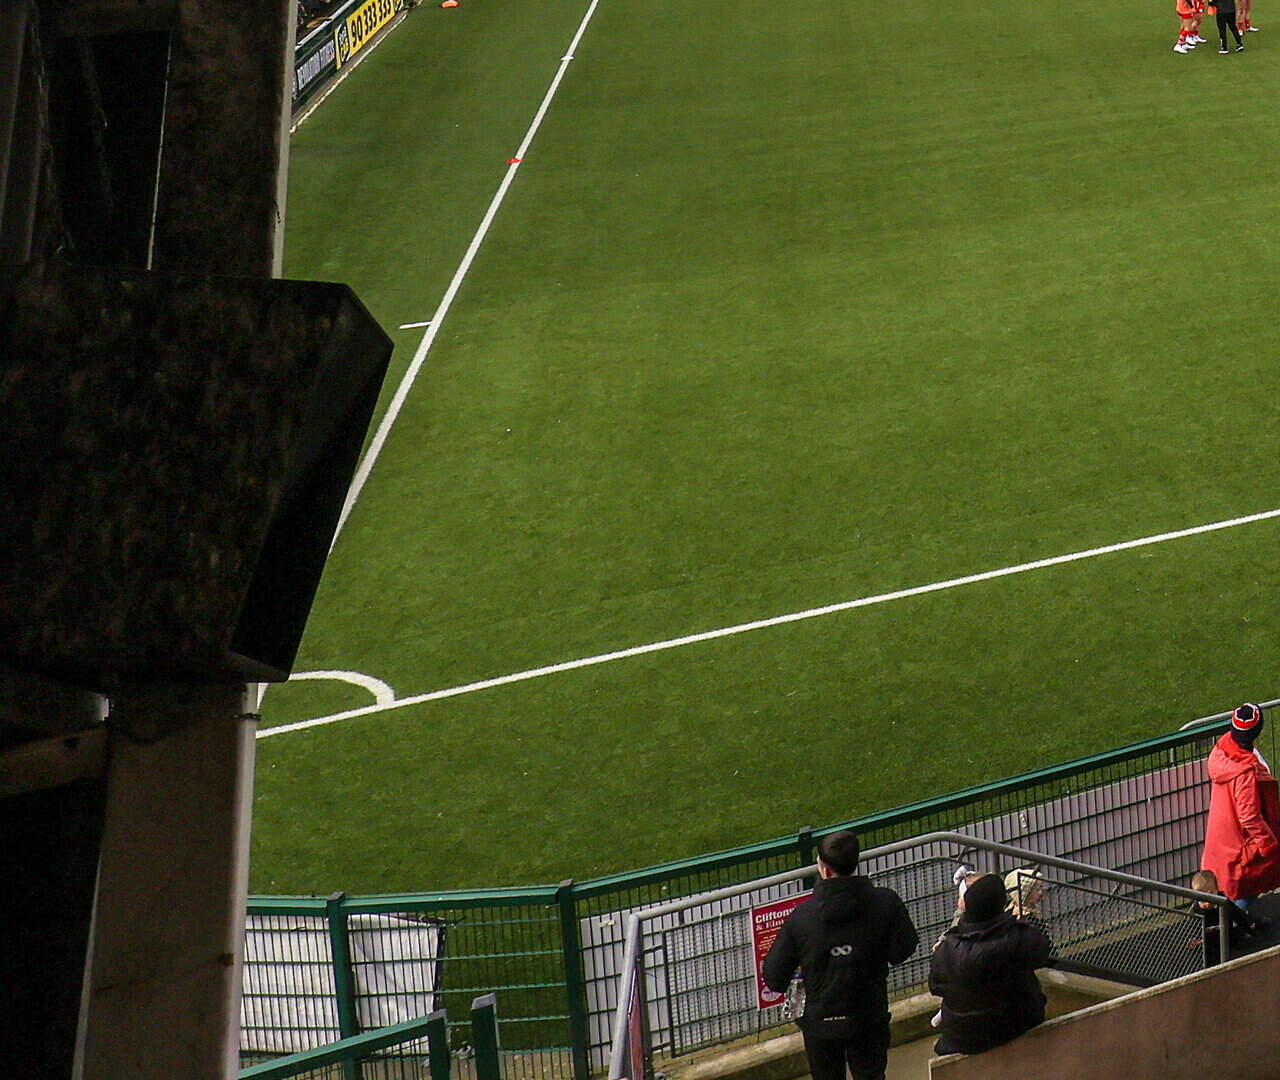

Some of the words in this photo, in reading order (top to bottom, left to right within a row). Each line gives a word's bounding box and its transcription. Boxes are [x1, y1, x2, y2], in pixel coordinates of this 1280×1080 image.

[351, 15, 363, 48] 90
[364, 1, 378, 36] 333
[755, 906, 796, 924] Cliftonv
